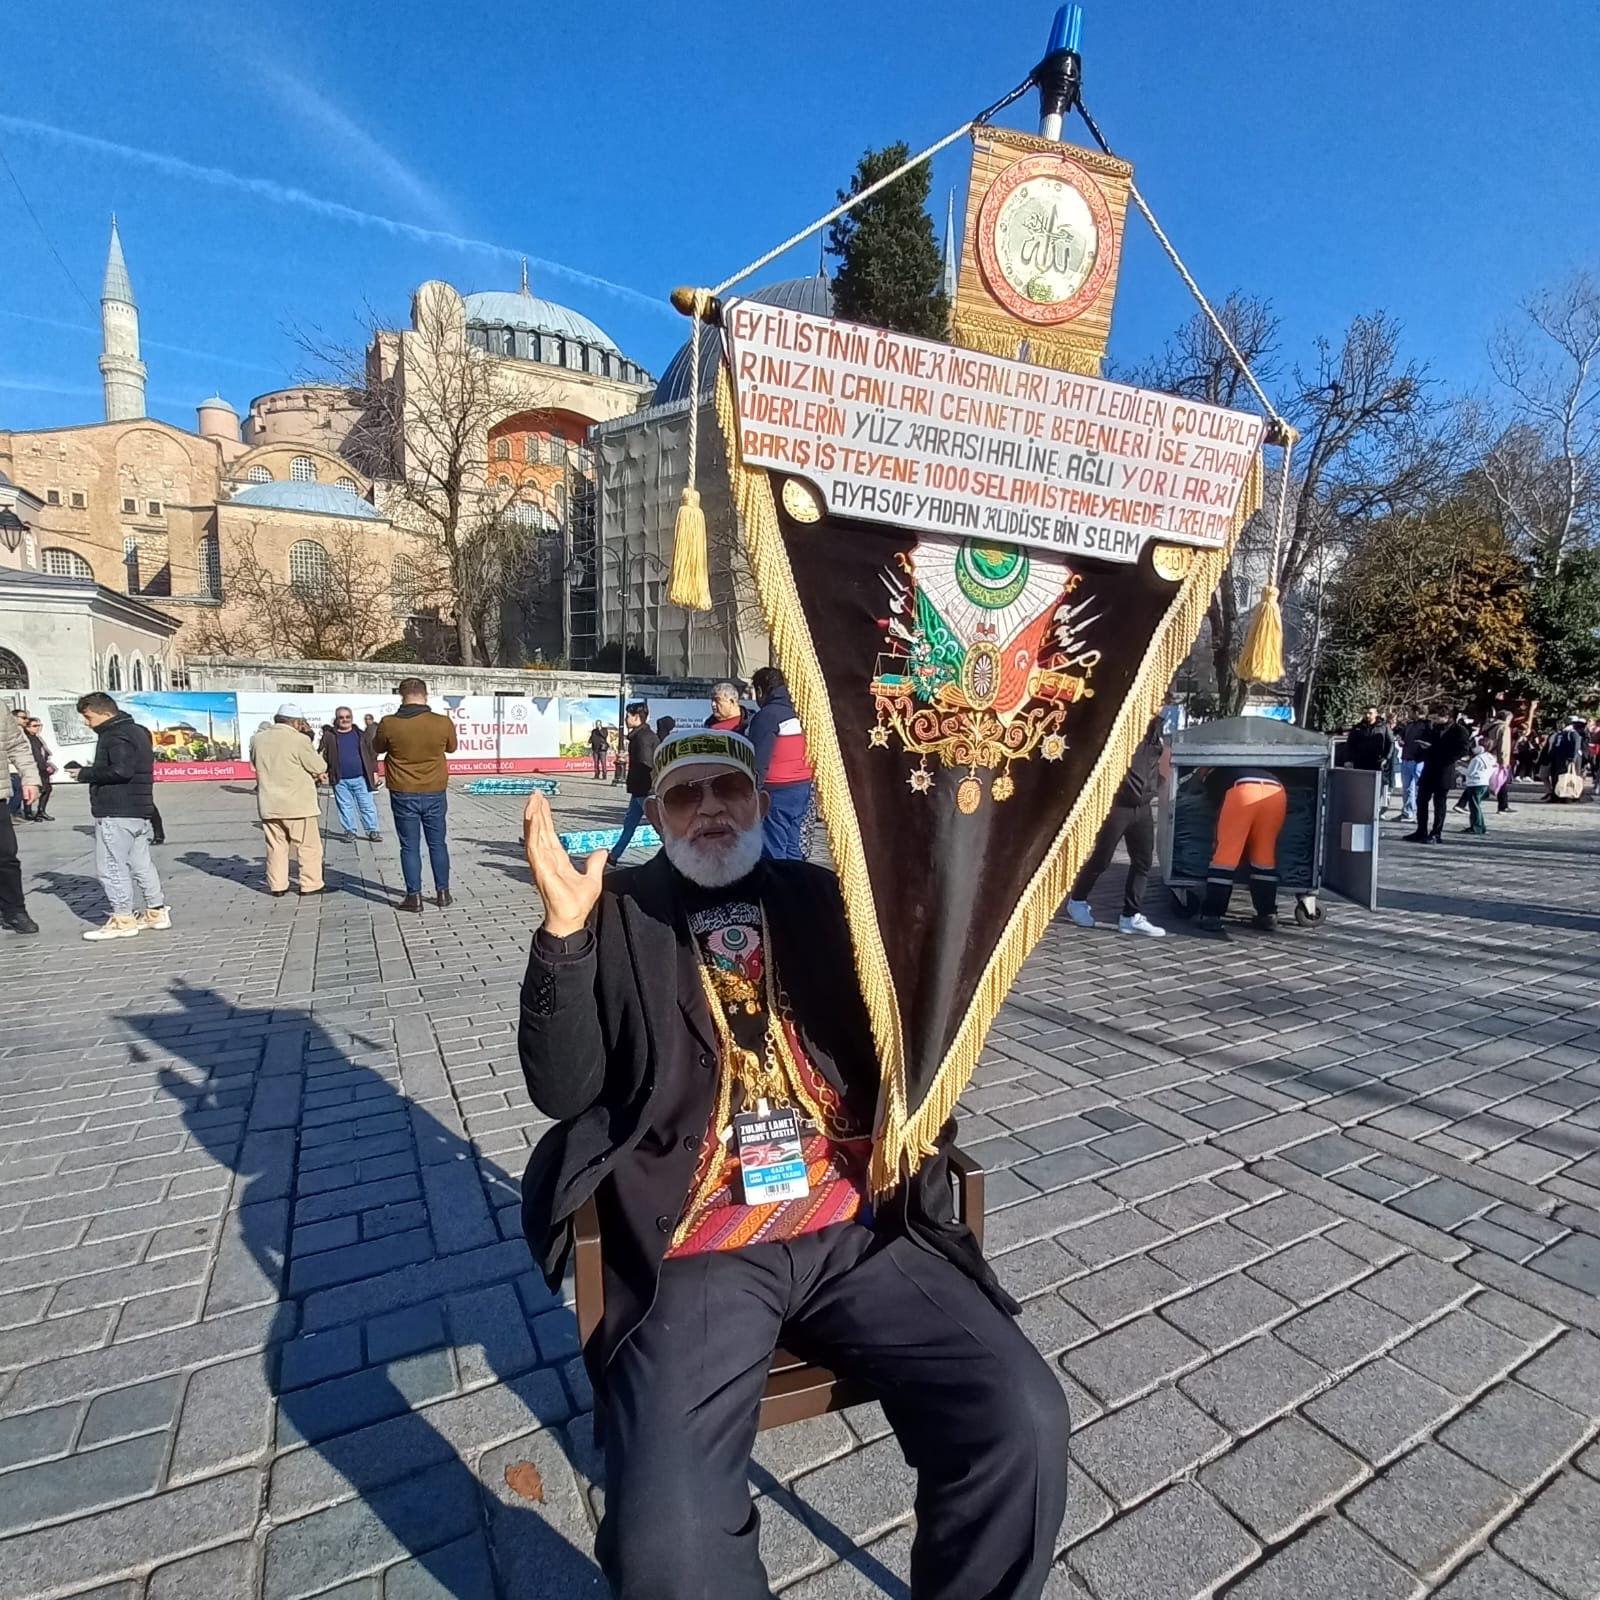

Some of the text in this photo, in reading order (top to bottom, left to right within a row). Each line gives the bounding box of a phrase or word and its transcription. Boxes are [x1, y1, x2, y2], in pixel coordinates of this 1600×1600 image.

[734, 309, 763, 341] EY
[874, 331, 945, 380] ÖRNEK
[947, 349, 1049, 402] İNSANLARI
[739, 351, 835, 396] RINIZIN
[840, 373, 934, 416] CANLARI
[1051, 415, 1154, 459] BEDENLERİ
[1156, 430, 1188, 466] İSE
[740, 384, 847, 437] LİDERLERİN
[852, 408, 903, 446] YÜZ
[904, 422, 986, 462] KARASI
[1066, 449, 1115, 487] AĞLI
[743, 430, 811, 469] BARIŞ
[814, 435, 920, 485] İSTEYENE
[924, 463, 970, 493] 1000
[971, 471, 1040, 506] SELAM
[831, 480, 981, 529] AYASOFYADAN
[982, 507, 1051, 540] KUDÜSE
[1053, 514, 1079, 546] BİN
[1083, 526, 1142, 555] SELAM
[443, 707, 470, 720] T.C.
[457, 736, 499, 751] NLIĞI
[471, 720, 528, 735] TURİZM
